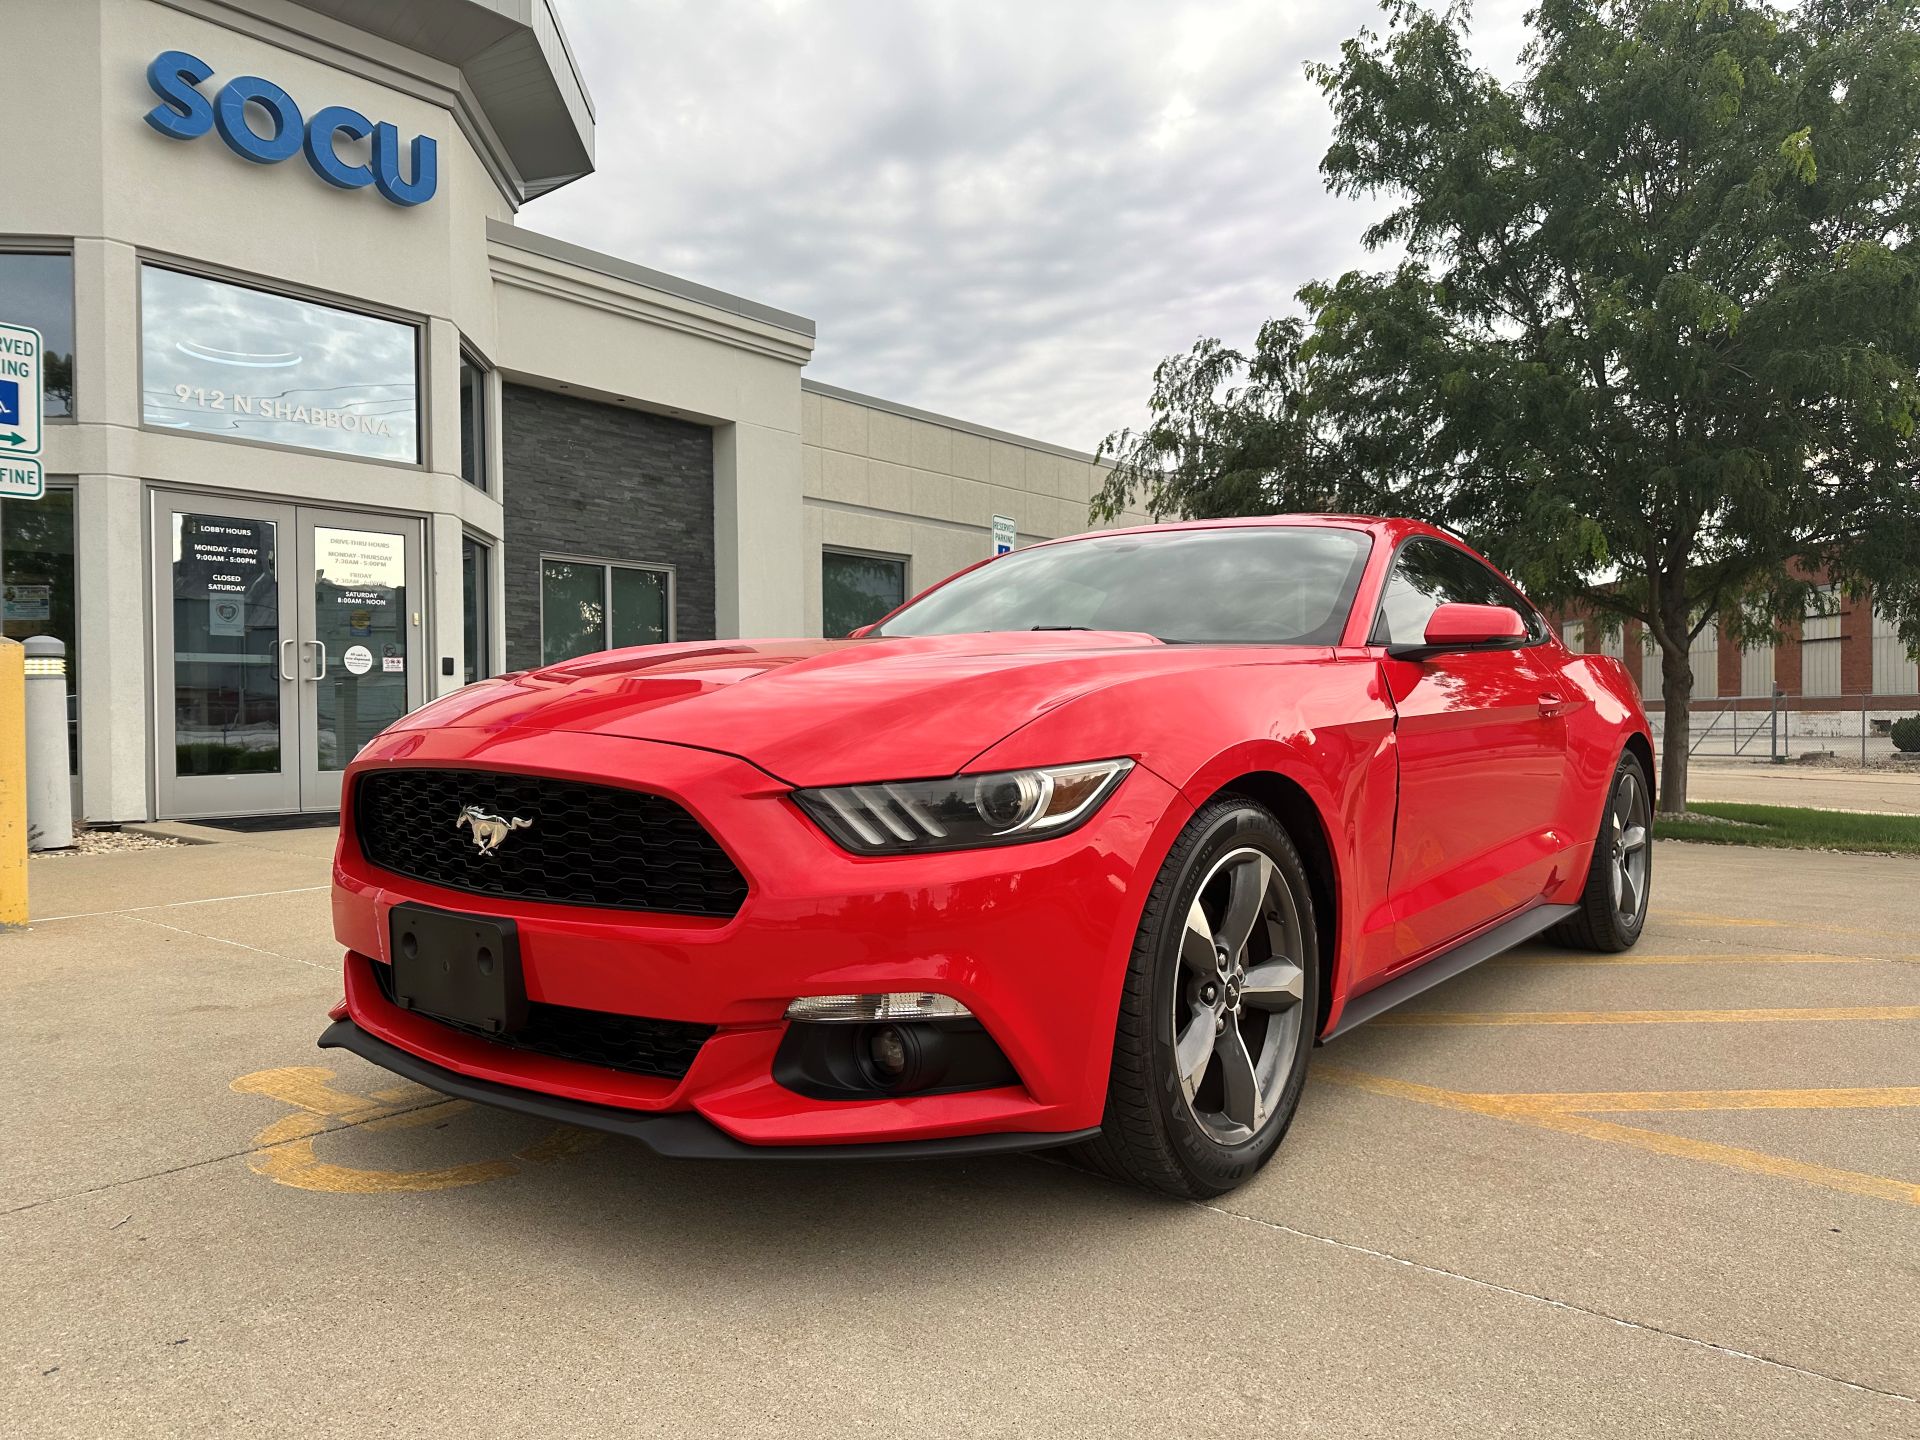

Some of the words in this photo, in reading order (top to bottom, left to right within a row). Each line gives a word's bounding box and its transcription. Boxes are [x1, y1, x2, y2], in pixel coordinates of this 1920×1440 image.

[143, 50, 438, 208] SOCU
[0, 336, 34, 356] VED
[175, 384, 225, 410] 912
[232, 394, 252, 414] N
[259, 398, 392, 438] SHABBONA
[200, 525, 225, 534] LOBBY
[994, 522, 1014, 534] RESERVED
[995, 532, 1013, 544] PARKING
[194, 544, 228, 552] MONDAY
[196, 554, 224, 562] 9:00AM
